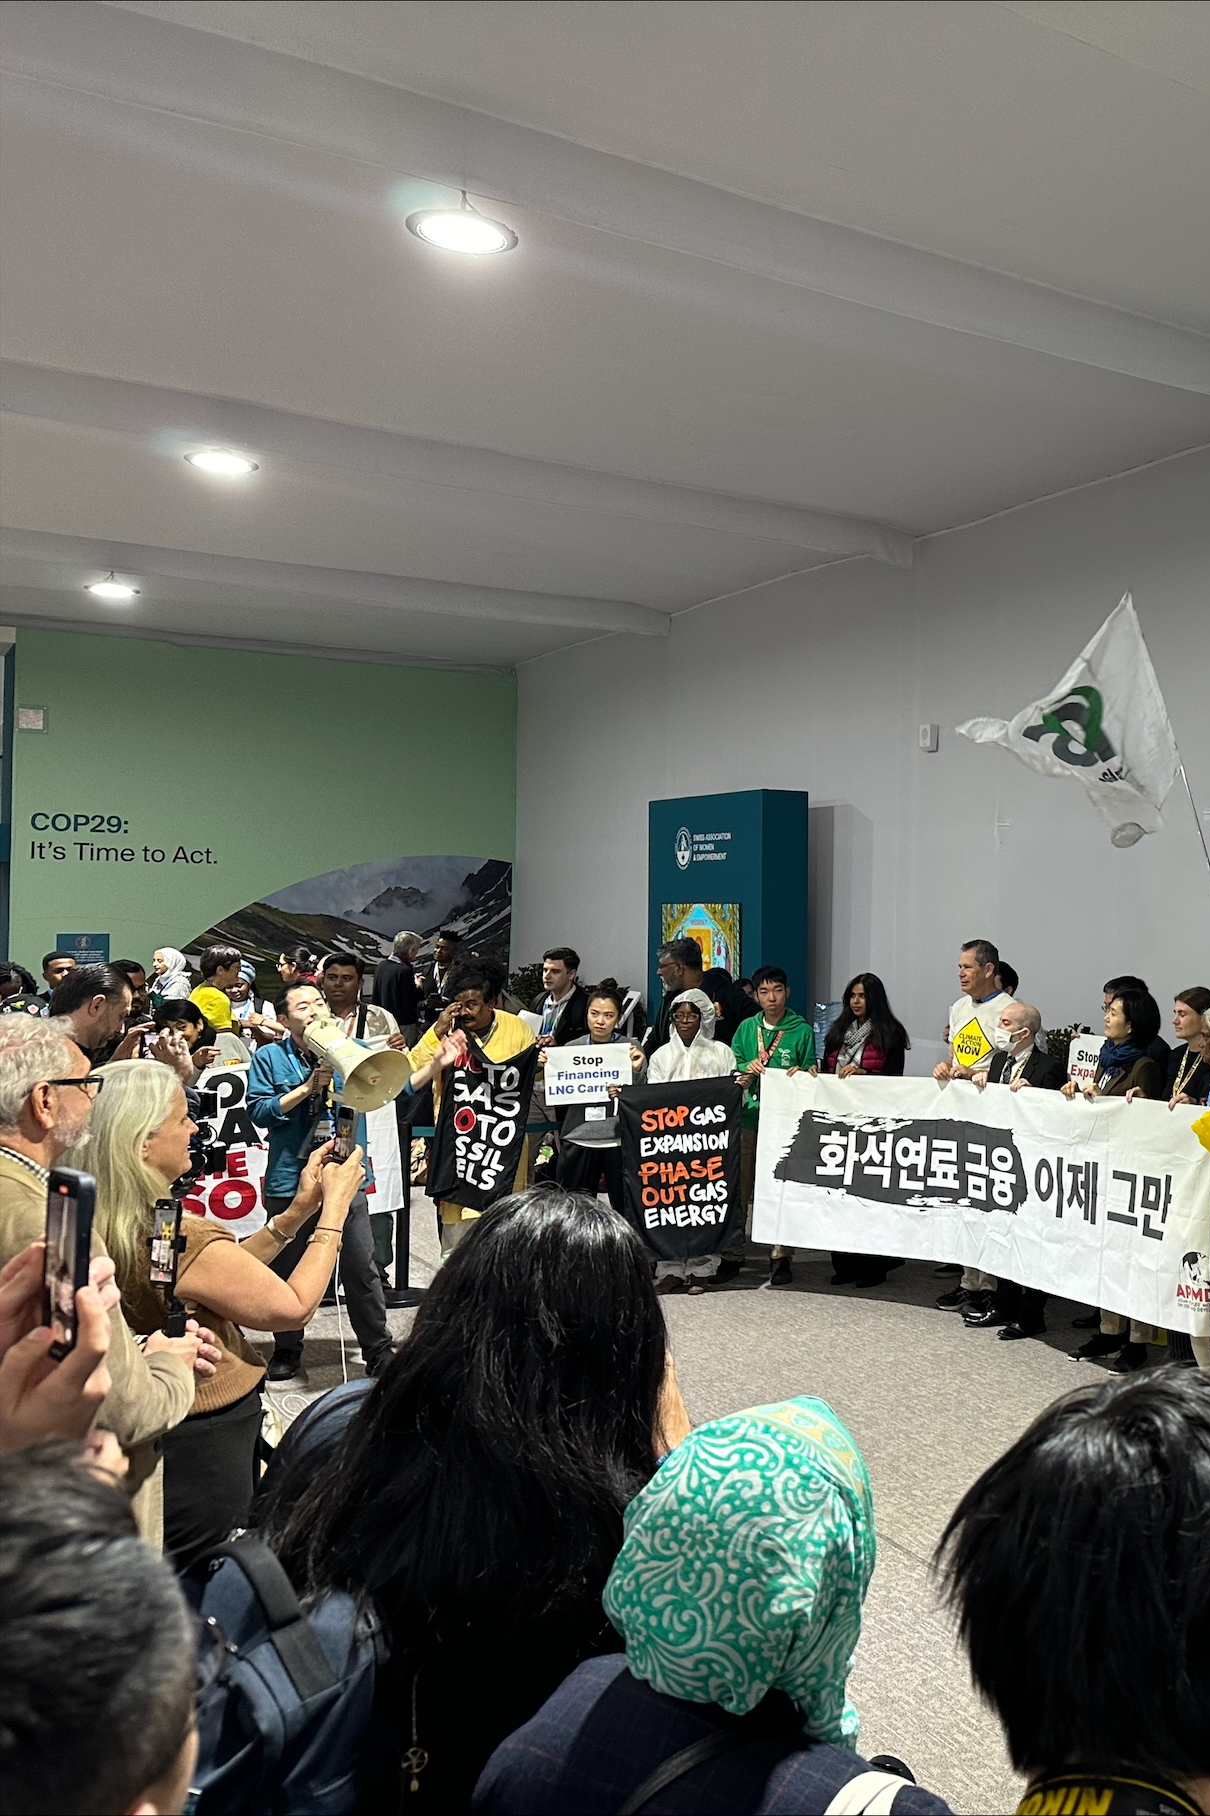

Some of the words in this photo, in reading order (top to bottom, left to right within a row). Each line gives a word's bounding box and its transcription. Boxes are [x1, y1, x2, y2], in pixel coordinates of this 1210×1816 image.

[30, 812, 129, 834] COP29:
[706, 832, 731, 841] ASSOCIATION
[73, 842, 135, 863] Time
[142, 844, 165, 864] to
[172, 846, 218, 865] Act.
[699, 843, 715, 851] WOMEN
[697, 852, 727, 861] EMPOWERMENT
[958, 1032, 982, 1042] CLIMATE
[960, 1039, 982, 1047] ACTION
[956, 1044, 981, 1056] NOW
[573, 1056, 603, 1066] Stop
[1077, 1050, 1099, 1066] Stop
[557, 1068, 619, 1080] Financing
[549, 1085, 574, 1095] LNG
[641, 1105, 689, 1132] STOP
[689, 1104, 727, 1126] GAS
[640, 1130, 730, 1157] EXPANSION
[638, 1156, 725, 1185] PHASE
[641, 1187, 688, 1207] OUT
[689, 1180, 728, 1202] GAS
[1034, 1156, 1099, 1226] 이제
[1107, 1169, 1172, 1241] 그만
[644, 1203, 729, 1229] ENERGY
